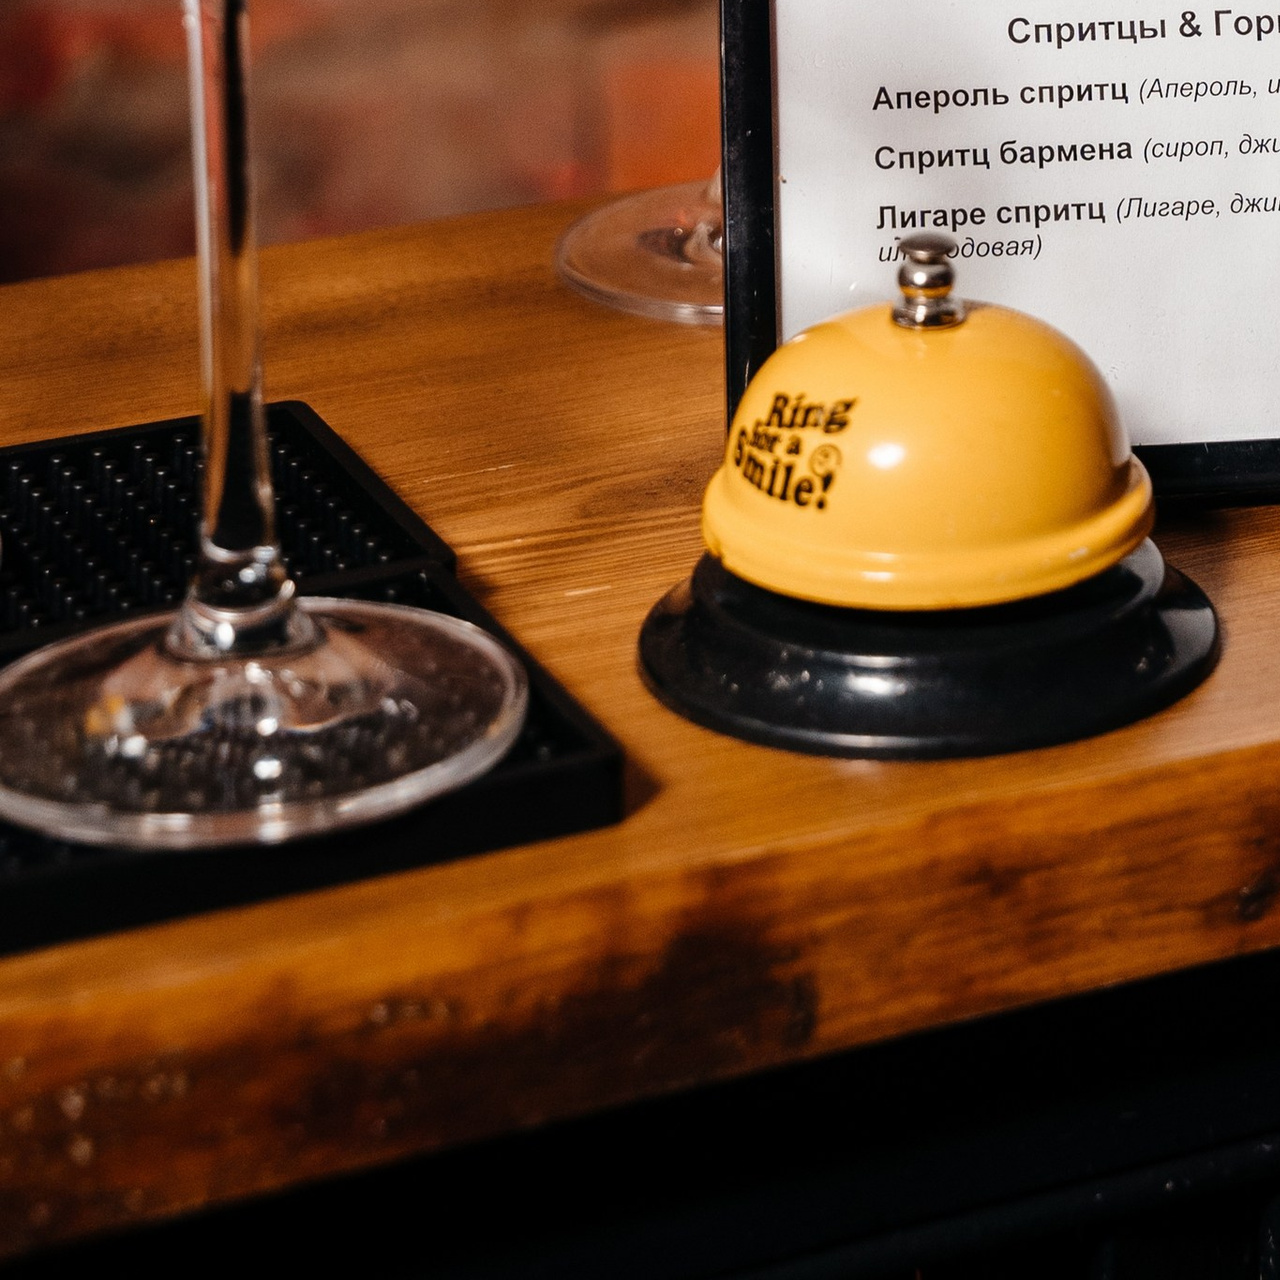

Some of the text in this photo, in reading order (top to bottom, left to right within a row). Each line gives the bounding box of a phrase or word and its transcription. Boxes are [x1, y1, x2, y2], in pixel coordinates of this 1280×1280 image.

[1007, 17, 1167, 50] Спритцы
[1178, 10, 1203, 38] &
[871, 85, 1010, 115] Апероль
[1019, 82, 1129, 109] спритц
[1139, 77, 1257, 105] (Апероль,
[874, 145, 991, 175] Спритц
[999, 139, 1133, 170] бармена
[1143, 137, 1229, 165] (сироп,
[876, 204, 987, 232] Лигаре
[996, 201, 1106, 229] спритц
[1116, 196, 1220, 225] (Лигаре,
[938, 234, 1043, 261] одовая)
[765, 392, 857, 434] Ring
